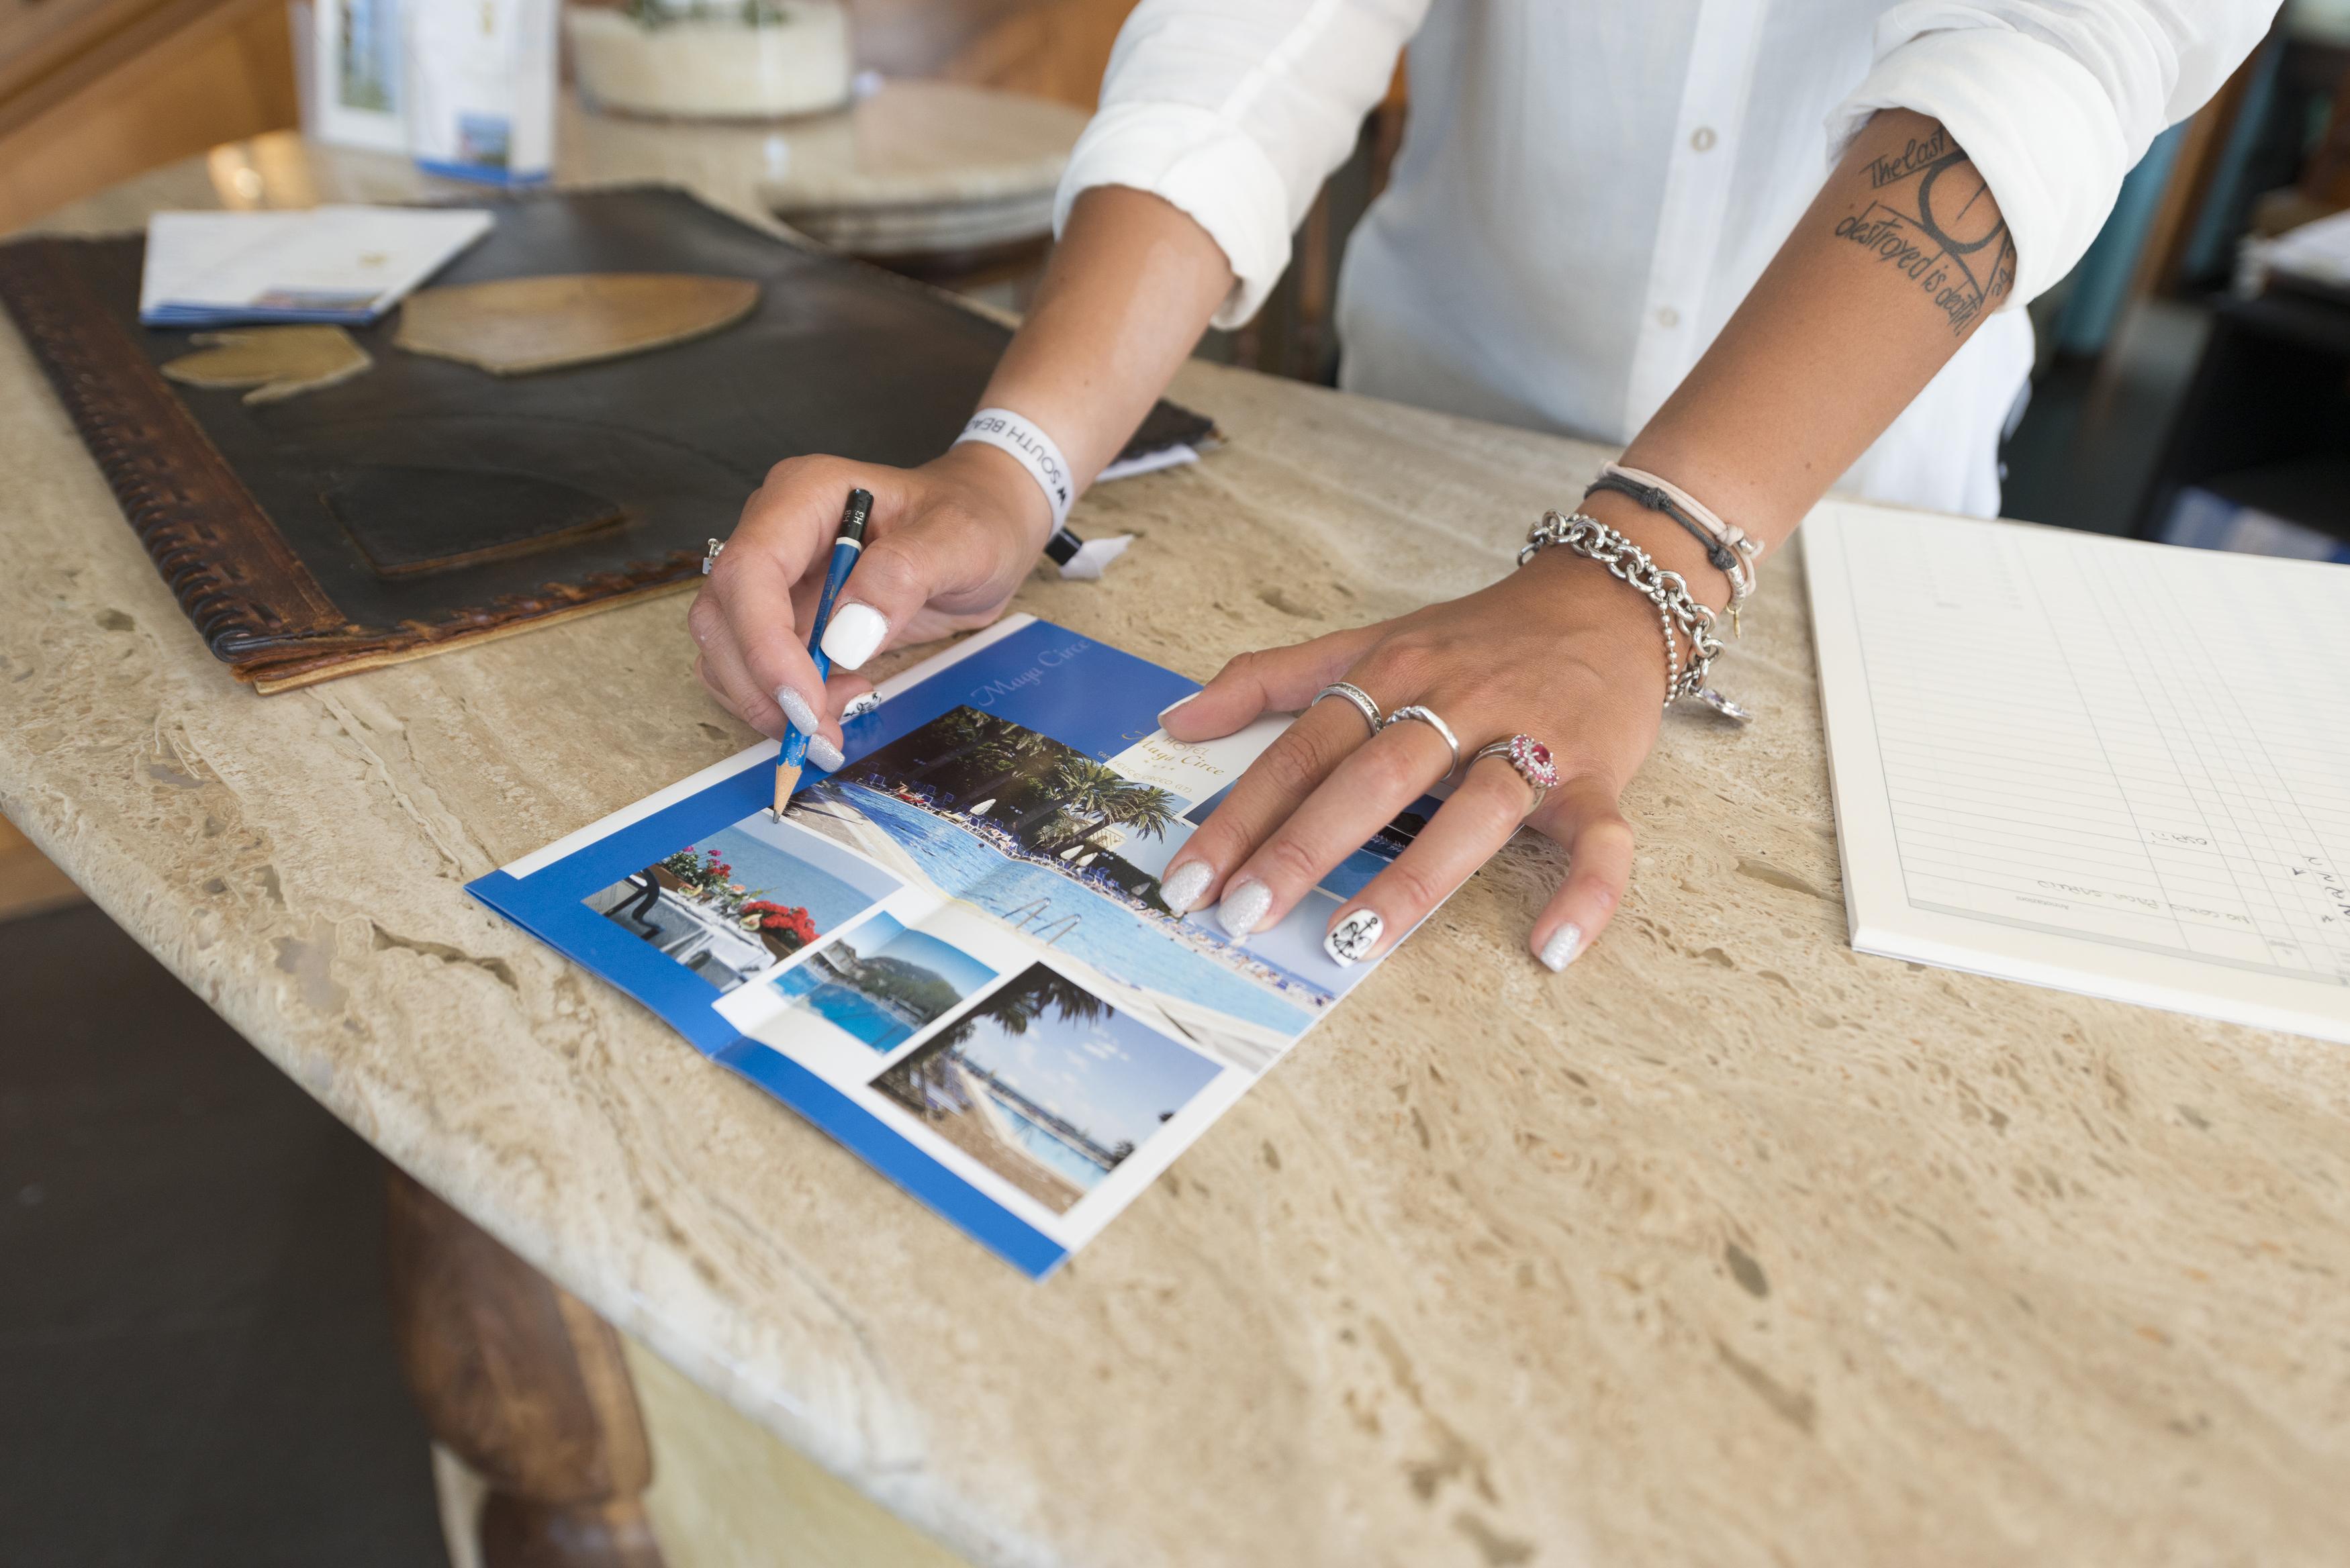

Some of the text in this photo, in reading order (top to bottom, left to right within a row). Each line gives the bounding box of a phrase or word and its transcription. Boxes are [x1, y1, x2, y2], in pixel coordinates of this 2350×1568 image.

[1859, 125, 1947, 189] The last
[1835, 200, 1945, 280] destroyed
[1921, 264, 1947, 293] is
[1006, 426, 1062, 485] SOUTH
[1037, 640, 1090, 667] Circe
[1162, 735, 1211, 757] HOTEL
[1112, 760, 1141, 779] FELICE
[1174, 783, 1193, 793] (LT)
[1181, 755, 1225, 776] Circe
